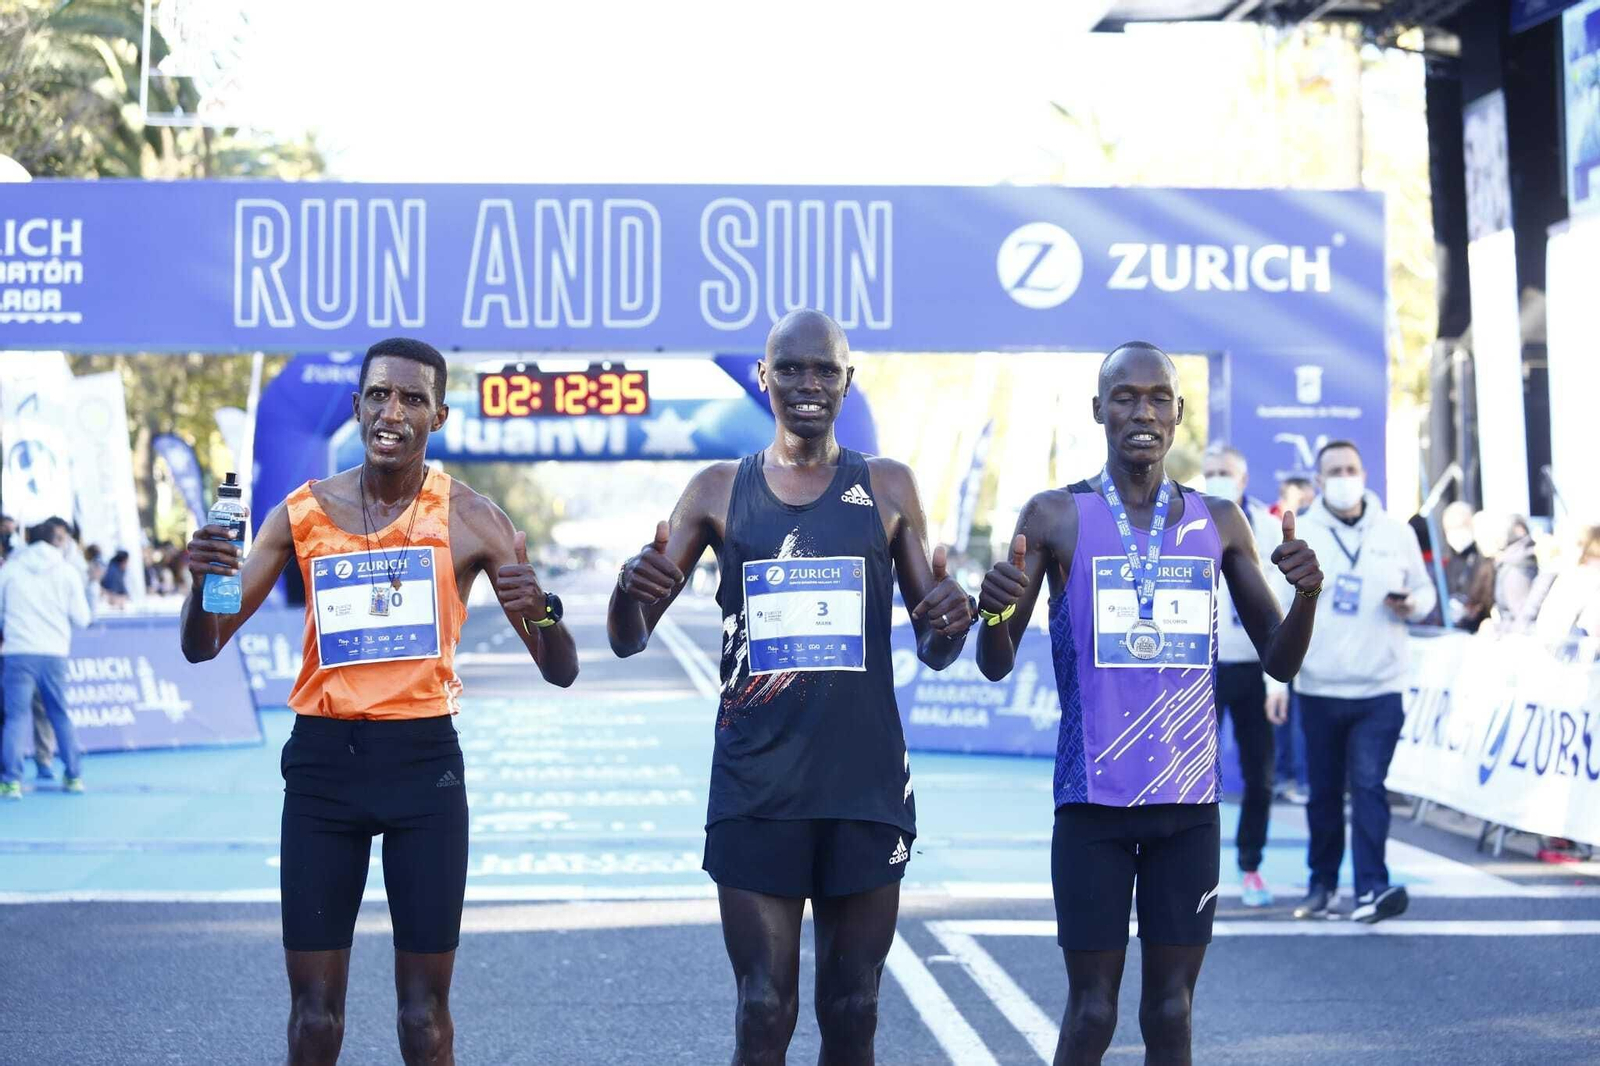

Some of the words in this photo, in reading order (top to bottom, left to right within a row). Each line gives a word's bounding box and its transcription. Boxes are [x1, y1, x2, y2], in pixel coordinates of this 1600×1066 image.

[0, 218, 83, 256] ICH
[233, 198, 426, 329] RUN
[462, 198, 662, 328] AND
[700, 197, 894, 331] SUN
[1107, 242, 1331, 292] ZURICH
[482, 373, 647, 417] 02:12:35
[841, 494, 874, 507] adidas
[357, 559, 408, 573] ZURICH
[1156, 566, 1192, 578] URICH
[789, 568, 841, 580] ZURICH
[816, 601, 829, 617] 3
[1170, 600, 1179, 615] 1
[66, 657, 135, 682] URICH
[436, 780, 461, 788] adidas
